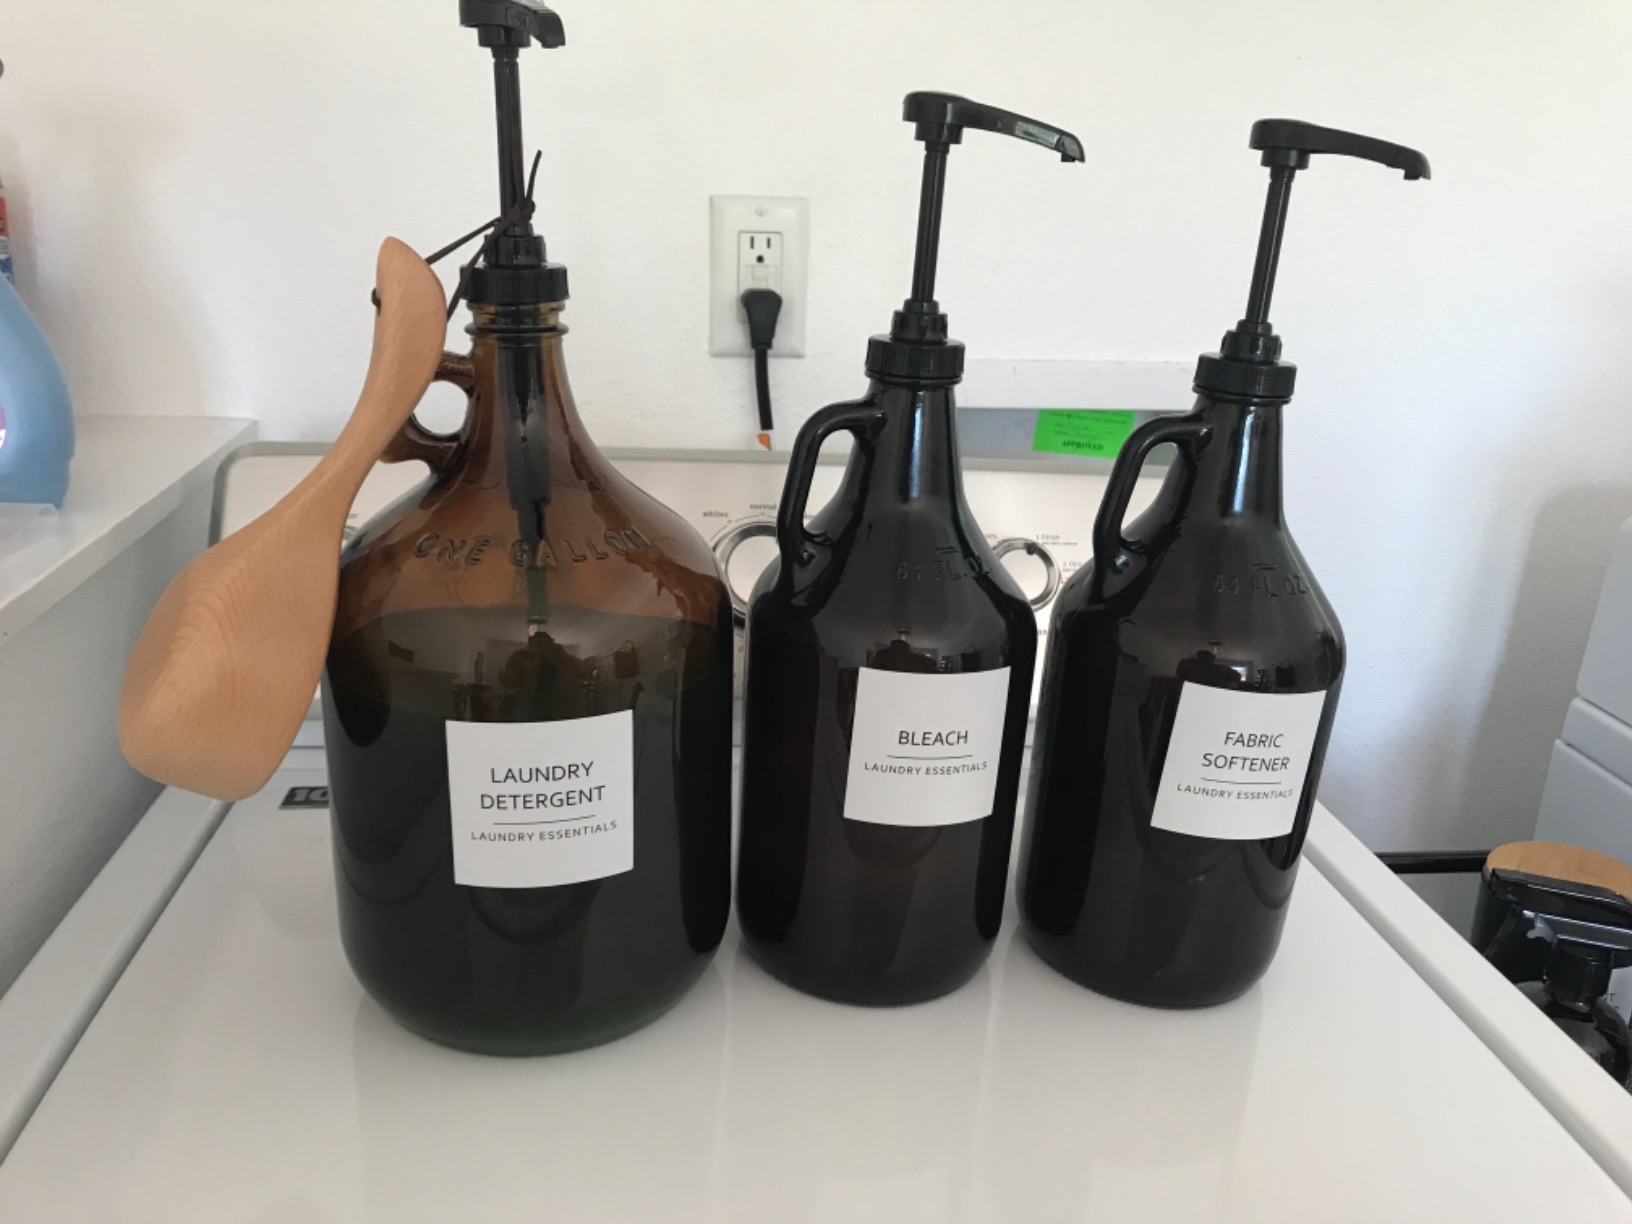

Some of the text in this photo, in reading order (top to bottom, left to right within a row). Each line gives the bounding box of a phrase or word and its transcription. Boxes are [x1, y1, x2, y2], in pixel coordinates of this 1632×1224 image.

[1062, 440, 1104, 451] APPROVED
[414, 528, 651, 567] ONE GALLON
[898, 730, 968, 746] BLEACH
[1224, 731, 1284, 748] FABRIC
[864, 761, 988, 775] LAUNDRY ESSENTIALS
[1201, 753, 1290, 772] SOFTENER
[490, 760, 595, 784] LAUNDRY
[480, 784, 606, 810] DETERGENT
[1177, 783, 1293, 800] LAUNDRY ESSENTIALS
[471, 819, 617, 842] LAUNDRY ESSENTIALS
